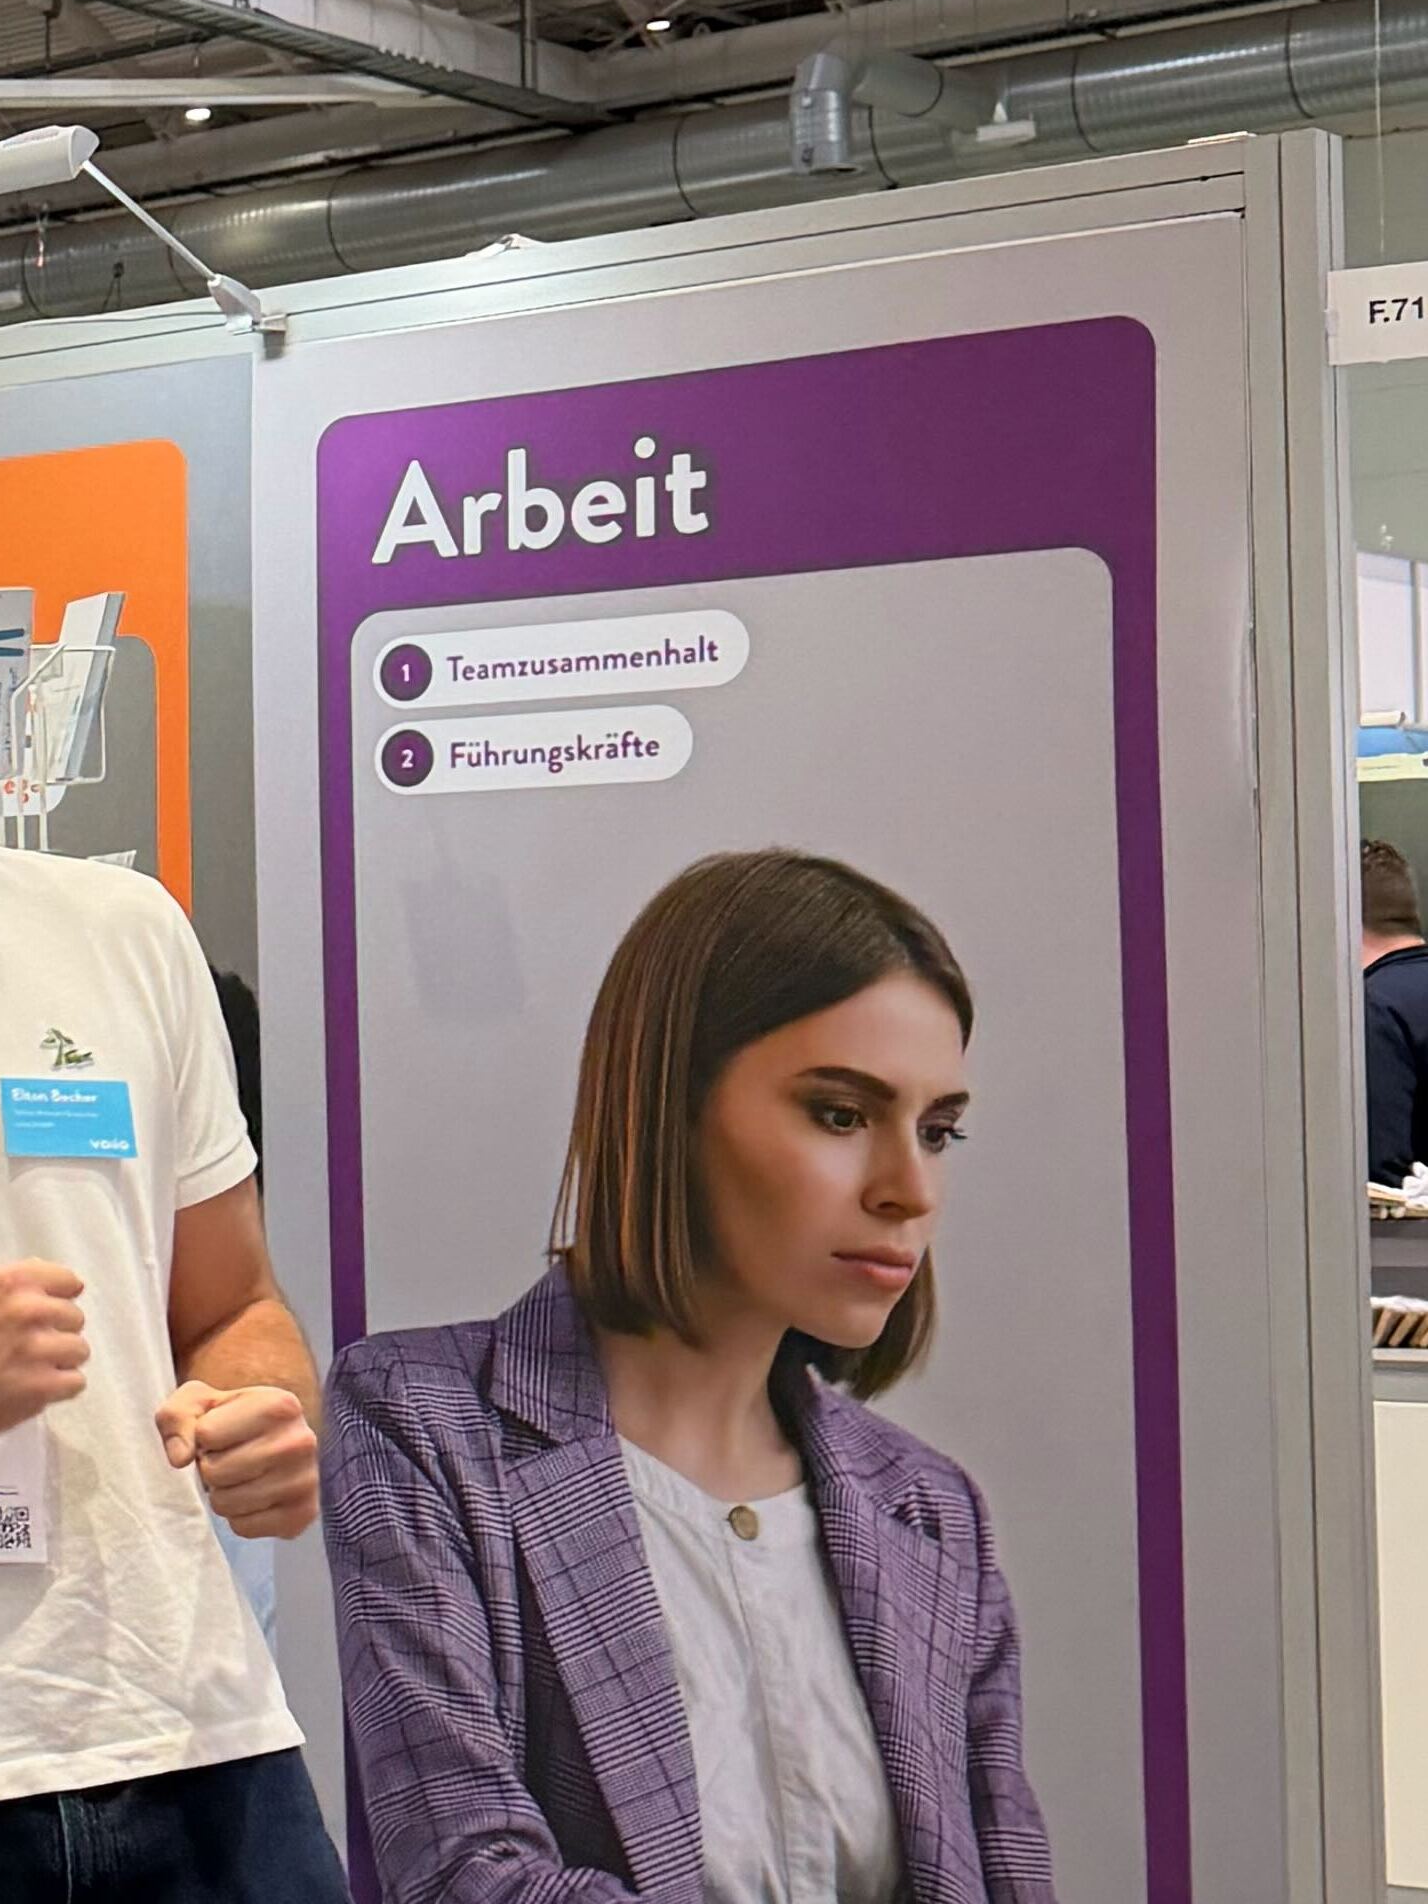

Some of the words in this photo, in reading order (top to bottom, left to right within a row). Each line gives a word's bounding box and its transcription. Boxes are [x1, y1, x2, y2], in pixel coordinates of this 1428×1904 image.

[1369, 296, 1424, 324] F.71
[371, 436, 709, 564] Arbeit
[401, 664, 411, 682] 1
[447, 635, 719, 682] Teamzusammenhalt
[401, 749, 414, 768] 2
[450, 730, 660, 774] Führungskräfte
